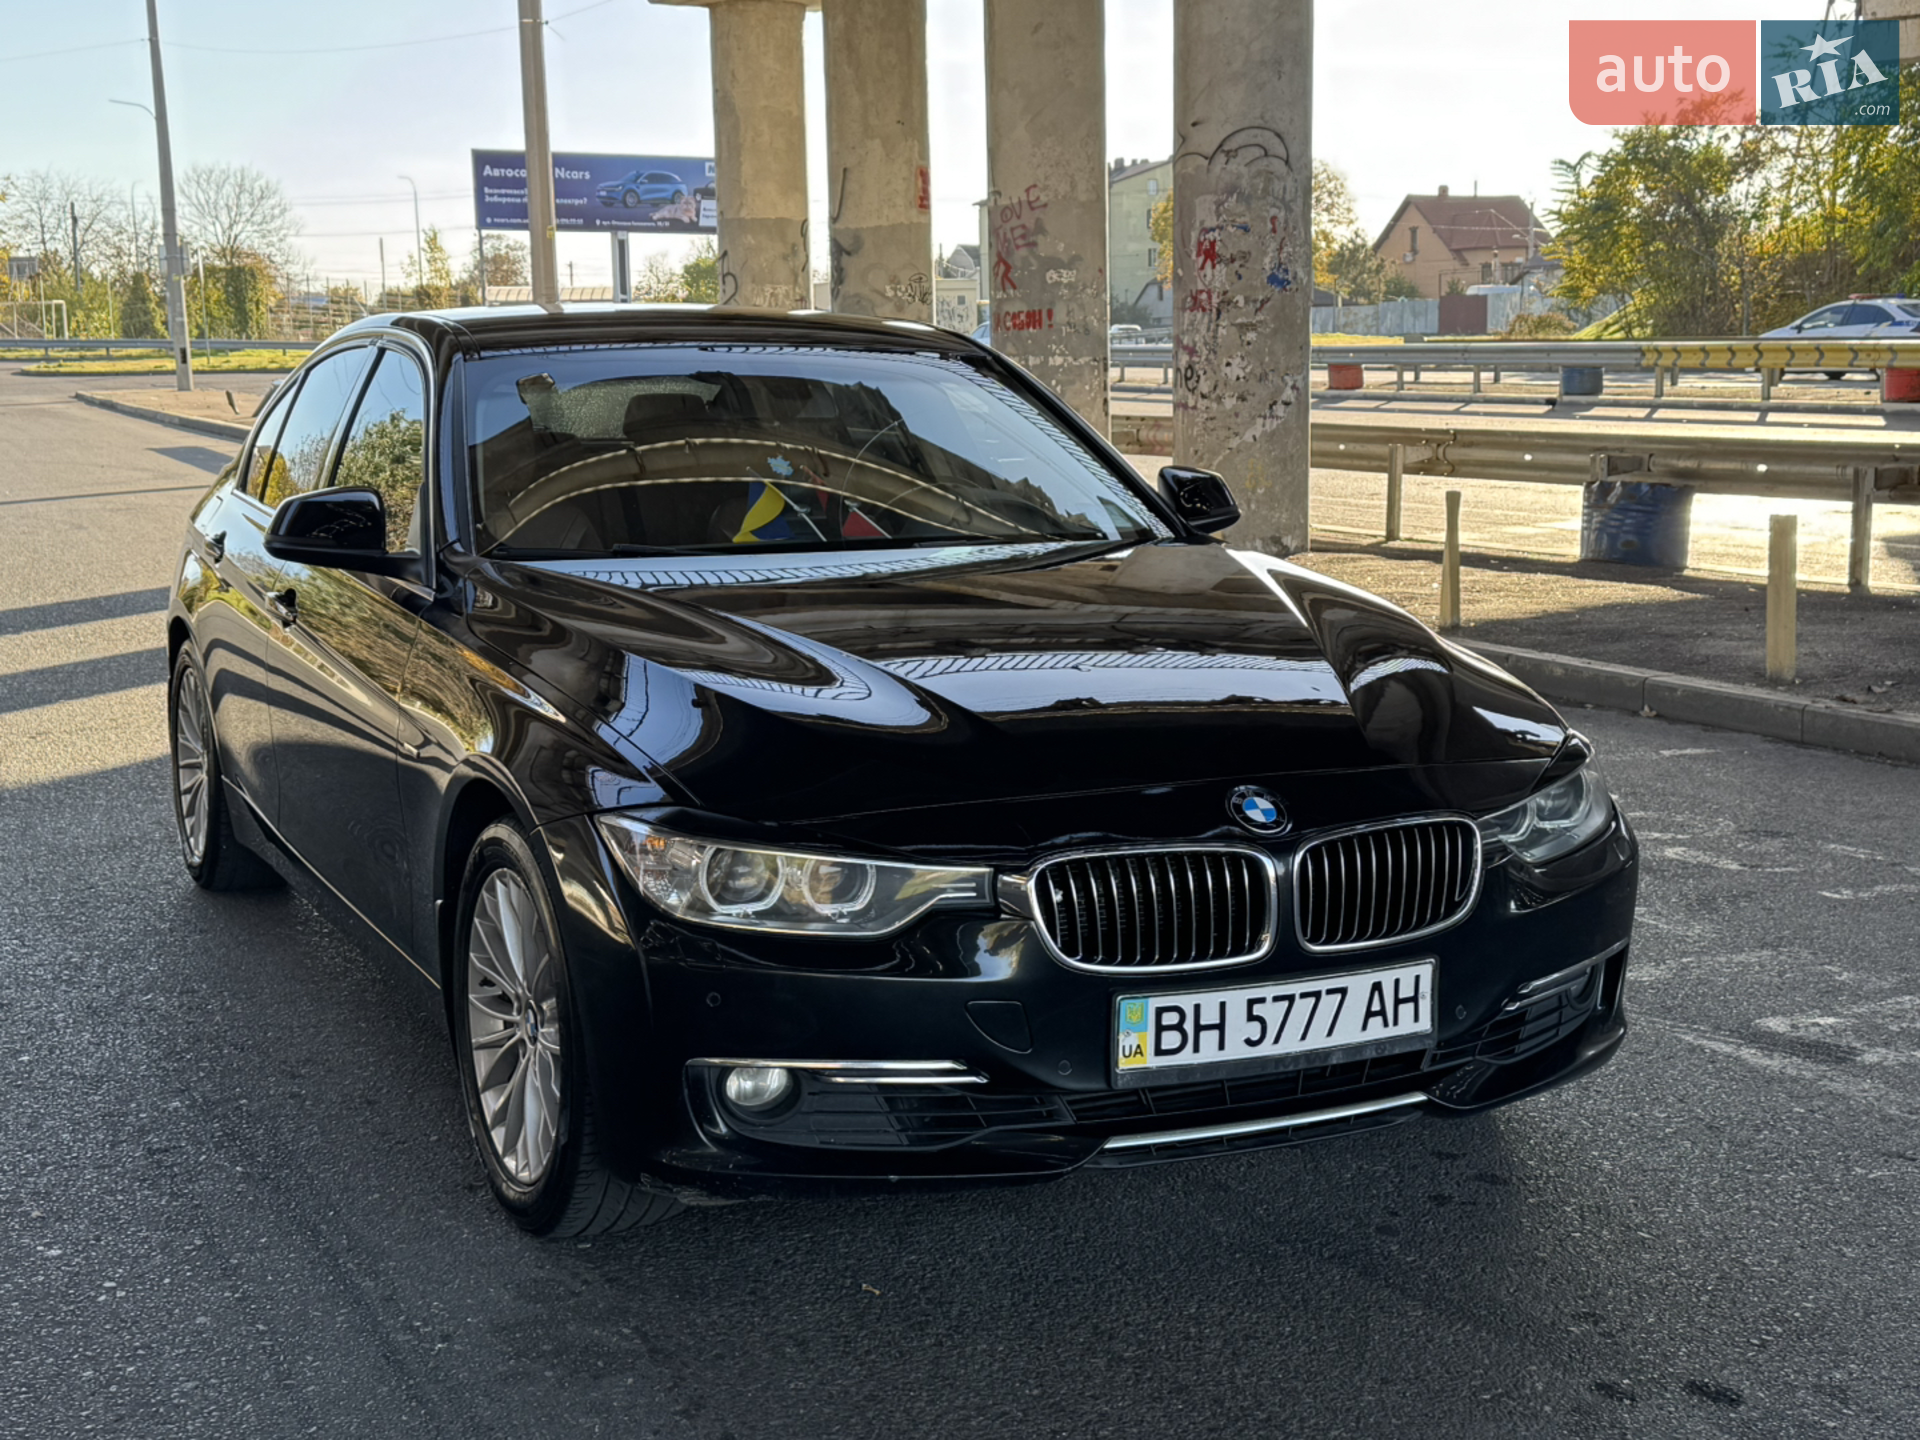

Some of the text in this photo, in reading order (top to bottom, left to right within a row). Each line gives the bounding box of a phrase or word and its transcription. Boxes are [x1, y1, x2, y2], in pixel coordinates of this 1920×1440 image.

[554, 167, 591, 180] Ncars
[1153, 974, 1421, 1057] BH 5777 AH
[1122, 1043, 1145, 1059] UA
